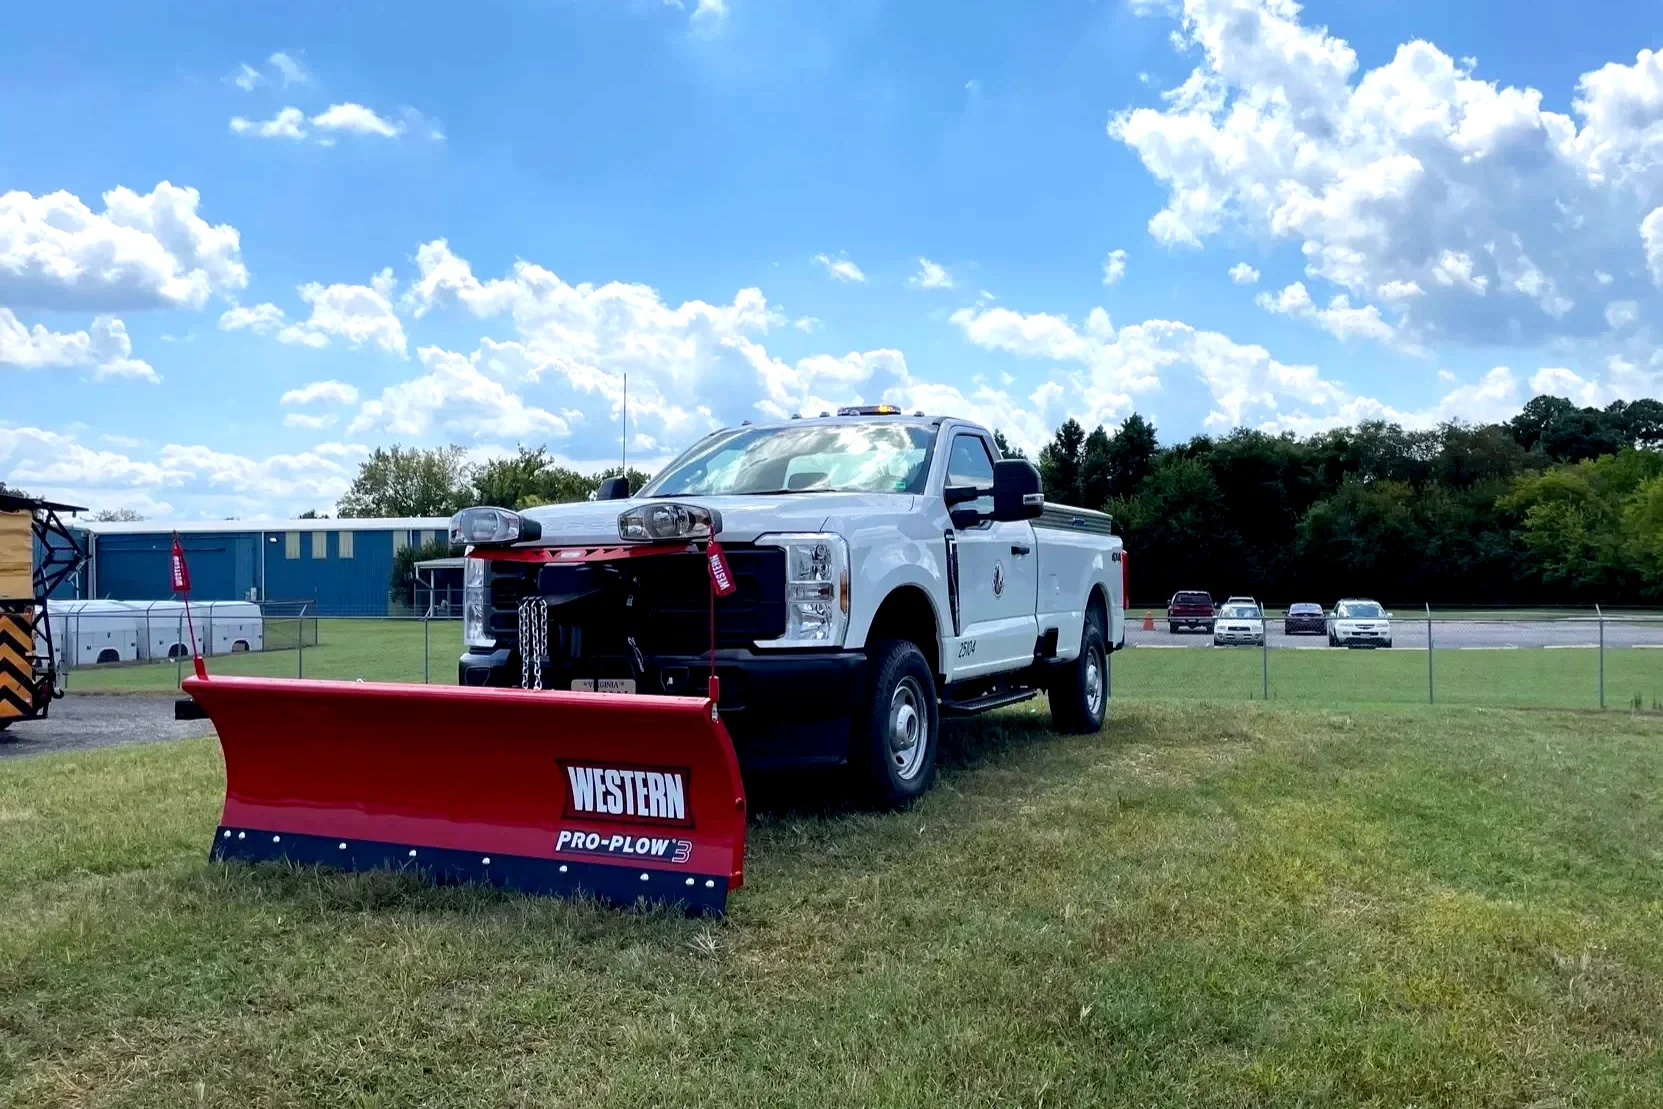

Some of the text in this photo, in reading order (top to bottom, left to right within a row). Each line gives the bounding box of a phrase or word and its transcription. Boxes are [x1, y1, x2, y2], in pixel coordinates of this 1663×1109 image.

[711, 554, 730, 590] WESTERN
[588, 681, 619, 689] VGINIA
[567, 766, 685, 819] WESTERN
[671, 840, 693, 864] 3
